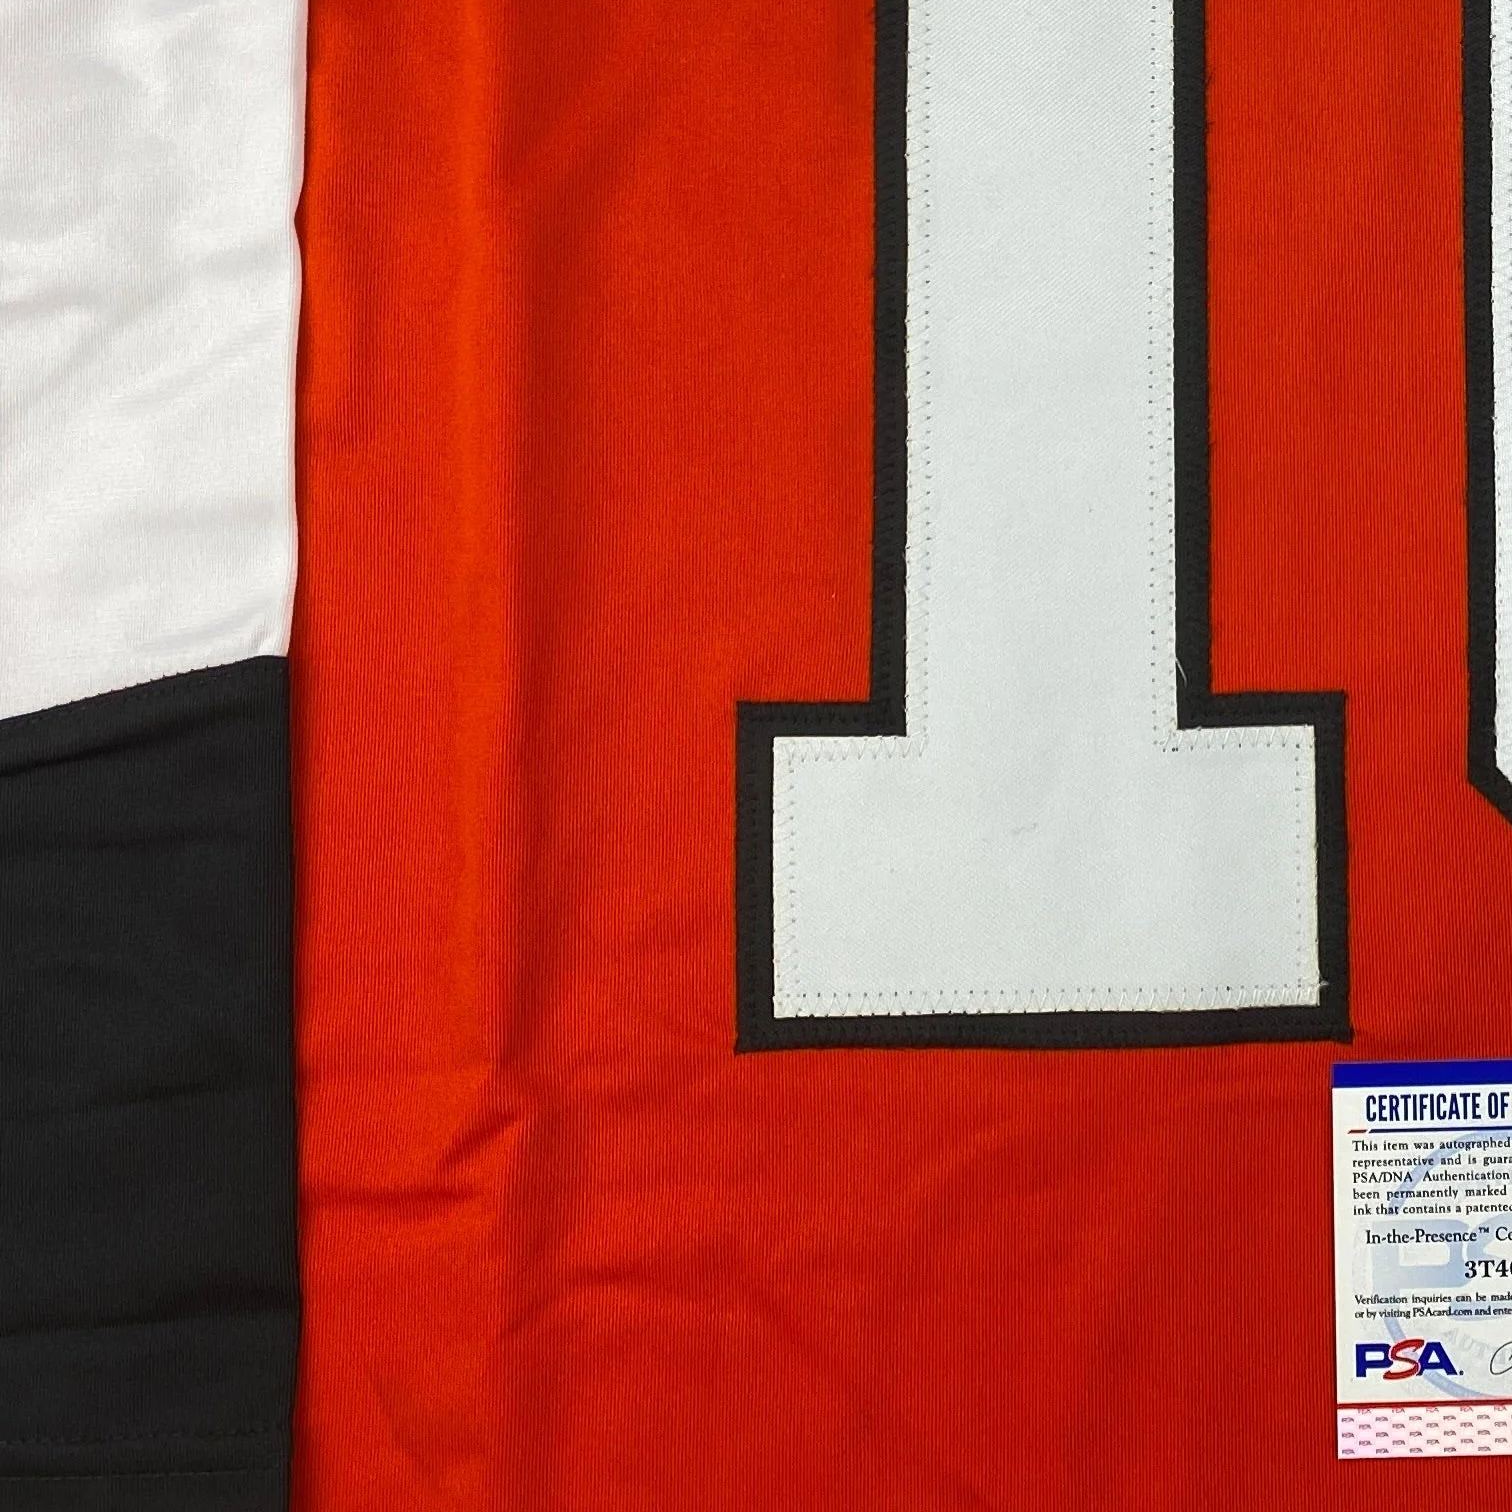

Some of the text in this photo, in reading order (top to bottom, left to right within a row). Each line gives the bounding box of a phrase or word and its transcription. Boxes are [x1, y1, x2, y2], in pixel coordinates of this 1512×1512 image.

[1366, 1092, 1482, 1122] CERTIFICATE
[1488, 1092, 1509, 1119] OF
[1352, 1140, 1378, 1151] This
[1384, 1140, 1408, 1150] item
[1414, 1141, 1434, 1150] was
[1440, 1137, 1510, 1151] autographed
[1353, 1156, 1434, 1169] representative
[1441, 1154, 1461, 1165] and
[1468, 1155, 1477, 1164] is
[1353, 1171, 1413, 1183] PSA/DNA
[1423, 1170, 1510, 1181] Authentication
[1353, 1188, 1380, 1199] been
[1387, 1186, 1458, 1201] permanently
[1465, 1185, 1507, 1196] marked
[1353, 1204, 1376, 1215] ink
[1376, 1204, 1399, 1215] that
[1403, 1203, 1451, 1214] contains
[1455, 1205, 1461, 1213] a
[1355, 1295, 1407, 1304] Verification
[1412, 1293, 1451, 1304] inquiries
[1456, 1294, 1471, 1302] can
[1476, 1292, 1486, 1302] be
[1366, 1308, 1376, 1319] by
[1379, 1308, 1410, 1319] visiting
[1413, 1306, 1472, 1317] PSAcard.com
[1475, 1306, 1491, 1316] and
